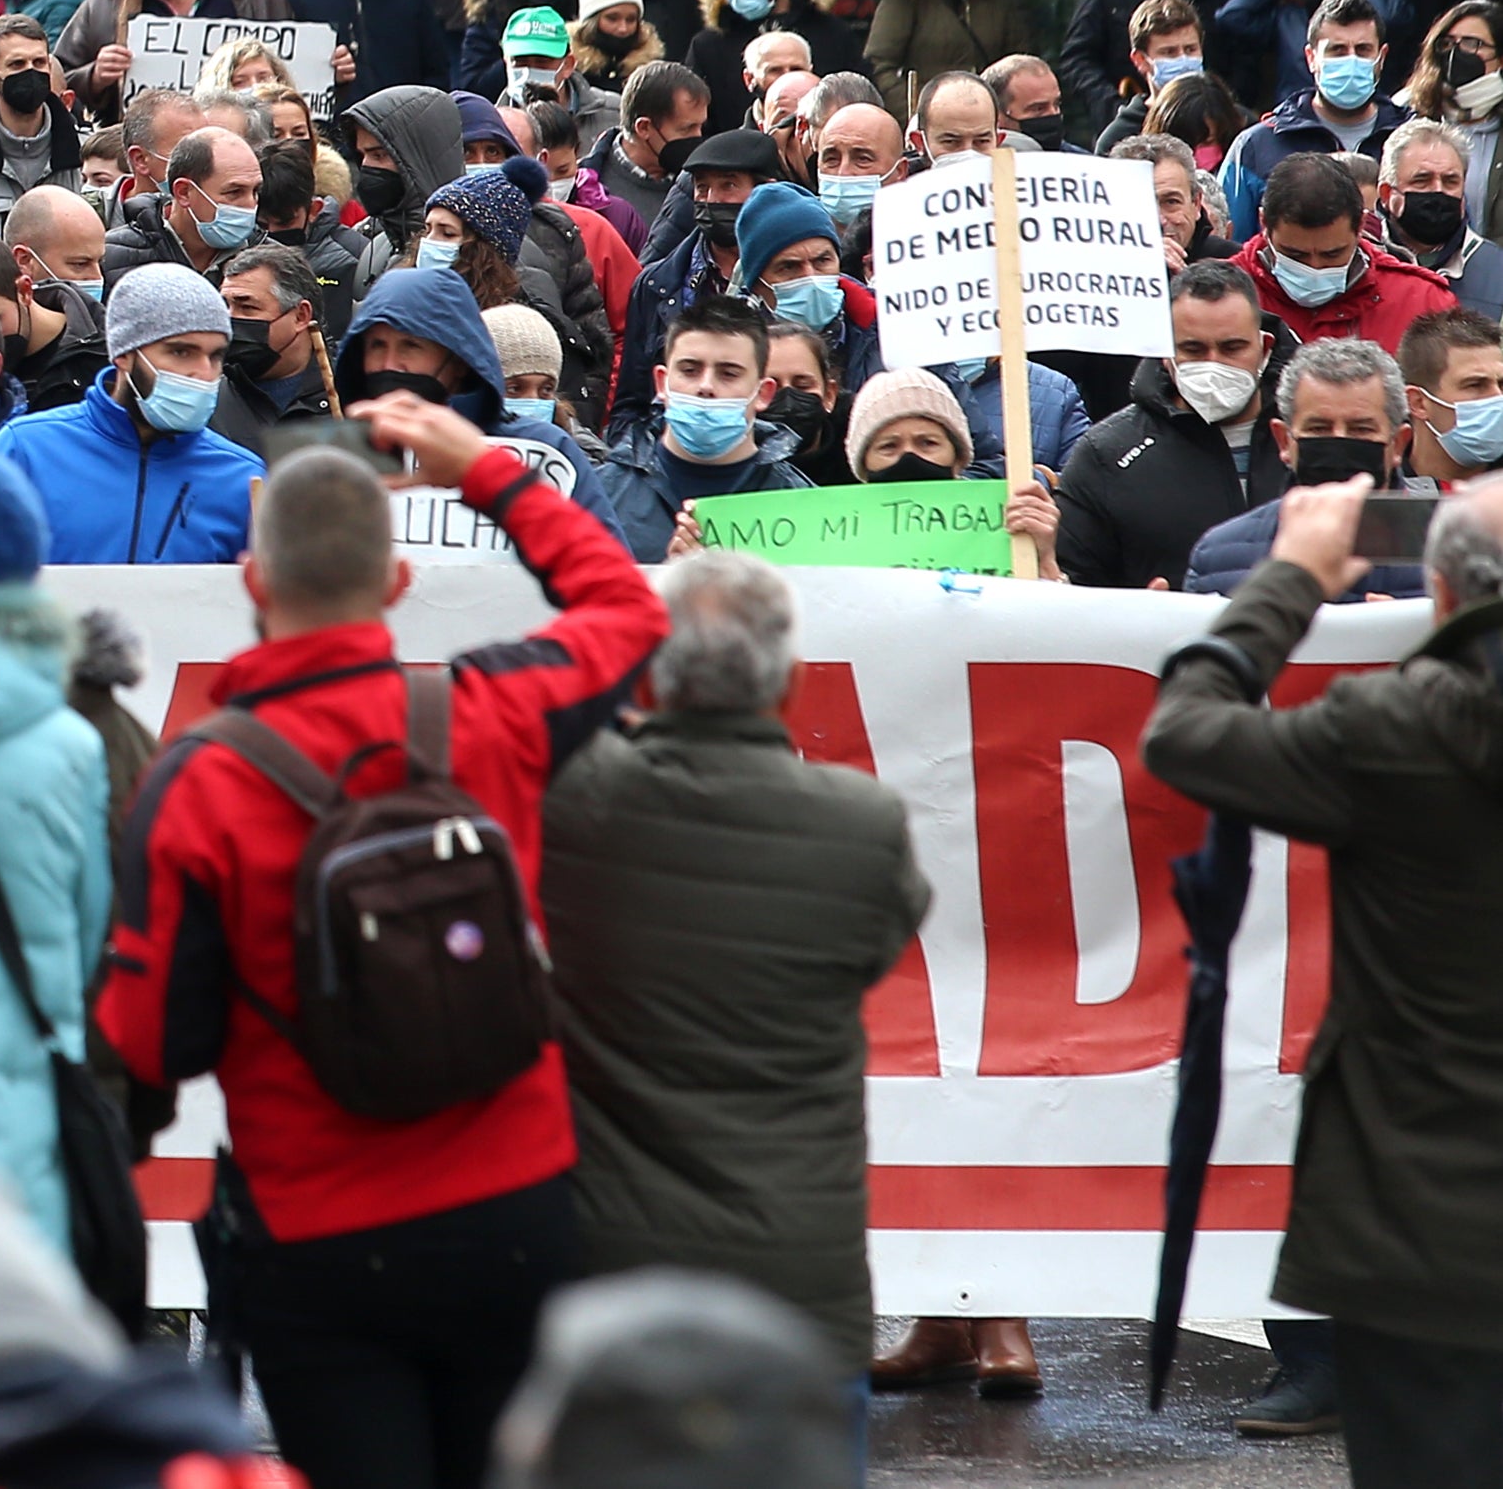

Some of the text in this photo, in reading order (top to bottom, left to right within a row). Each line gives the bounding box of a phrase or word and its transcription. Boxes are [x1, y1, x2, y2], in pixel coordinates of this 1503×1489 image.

[145, 22, 189, 55] EL
[924, 173, 1112, 218] CONEJERÍA
[887, 217, 1155, 264] DE MEDO RURAL
[885, 272, 1163, 315] NIDO DE UROCRATAS
[936, 316, 953, 337] Y
[700, 516, 796, 550] AMO
[881, 499, 1007, 535] TRABAJ
